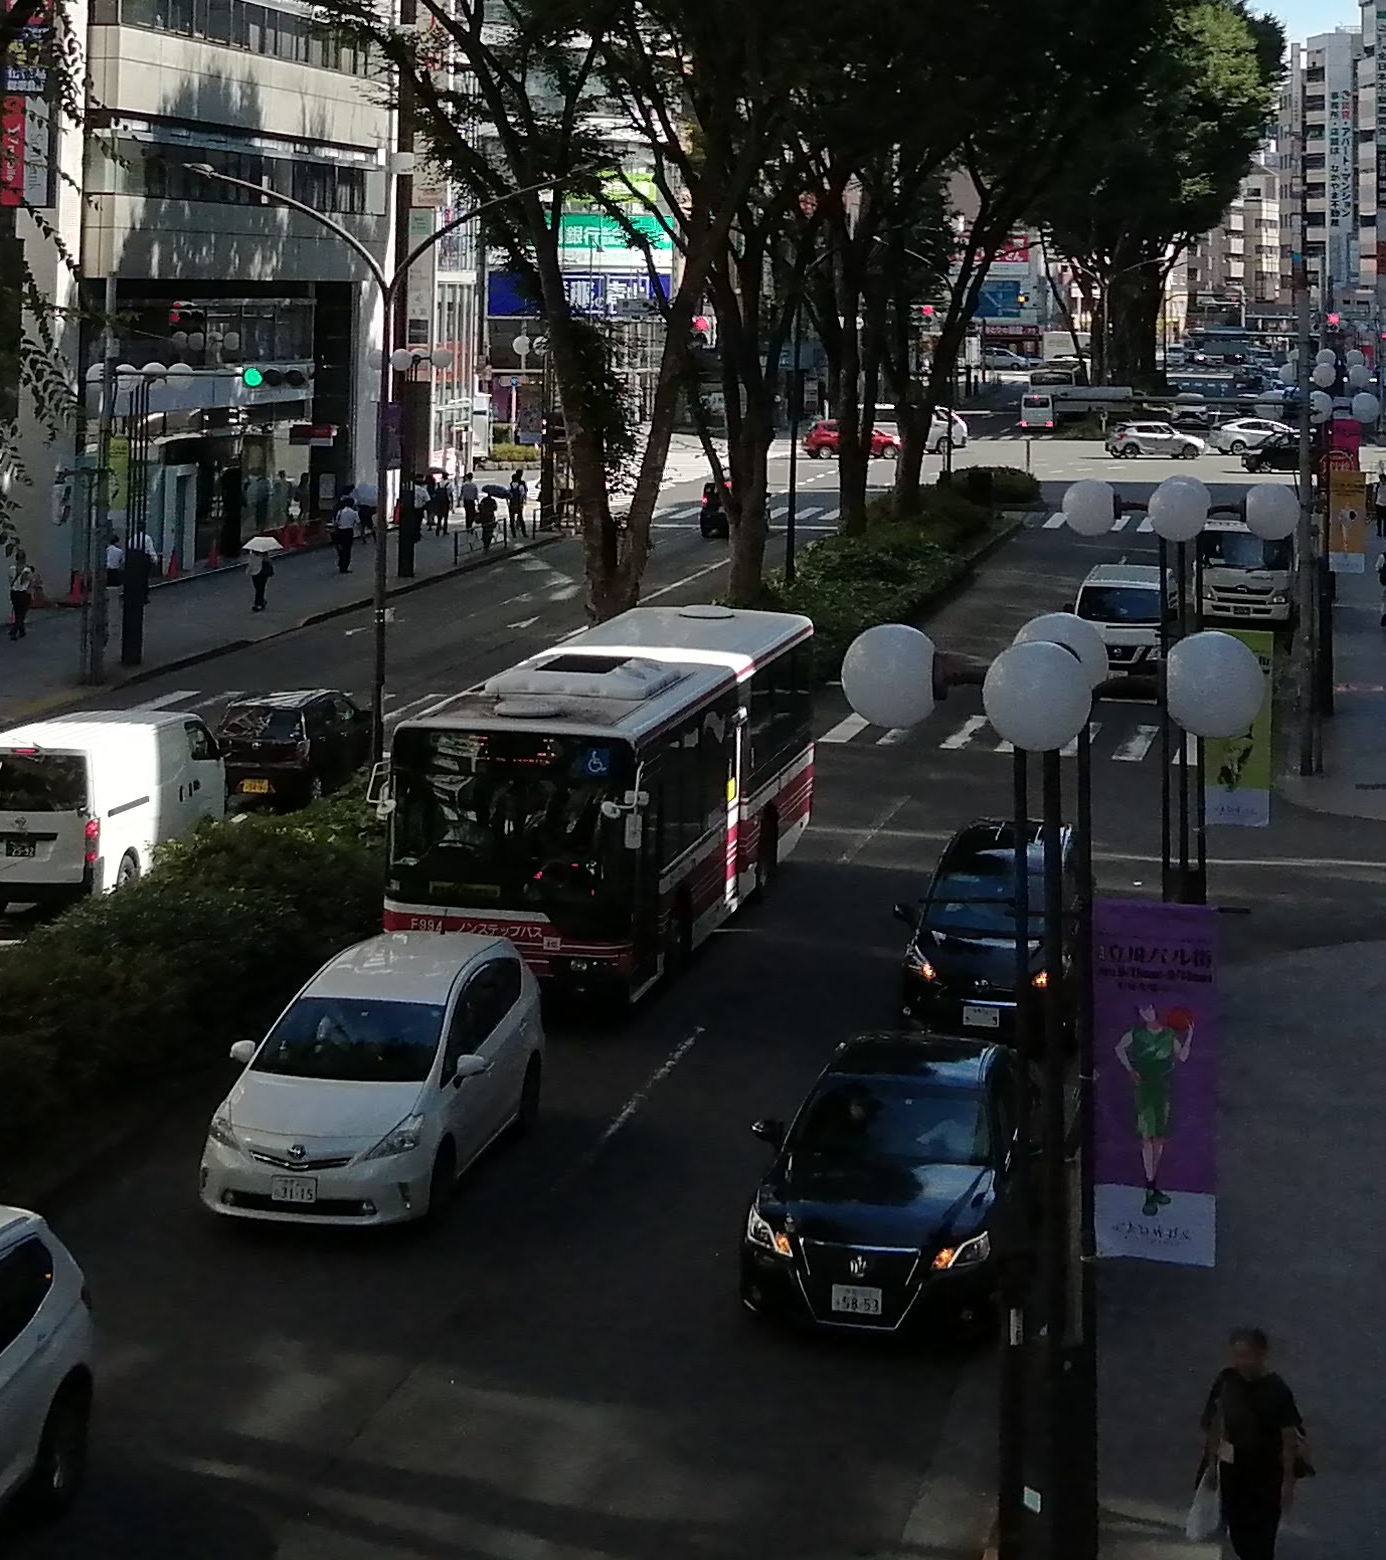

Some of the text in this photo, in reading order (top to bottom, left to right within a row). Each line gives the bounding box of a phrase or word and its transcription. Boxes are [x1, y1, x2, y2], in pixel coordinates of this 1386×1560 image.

[458, 920, 544, 939] ノンステップバス
